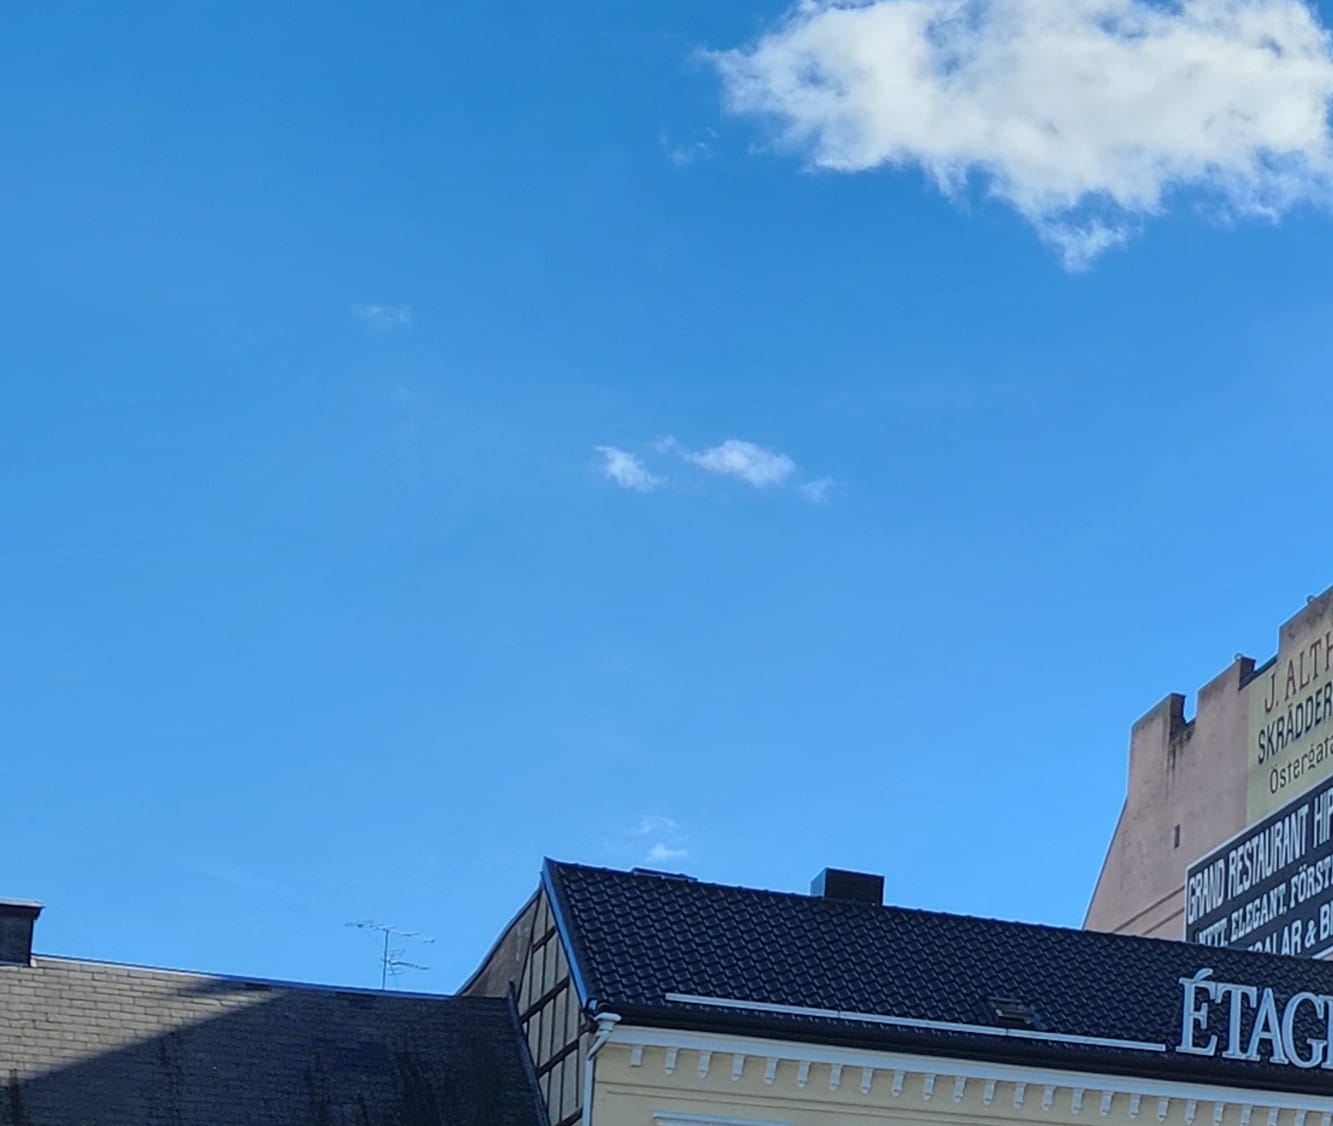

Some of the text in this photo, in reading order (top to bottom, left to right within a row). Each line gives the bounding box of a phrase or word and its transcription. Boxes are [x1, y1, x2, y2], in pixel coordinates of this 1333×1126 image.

[1264, 672, 1279, 713] J.
[1187, 858, 1225, 925] GRAND
[1227, 803, 1309, 900] RESTAURANT
[1304, 920, 1316, 948] &
